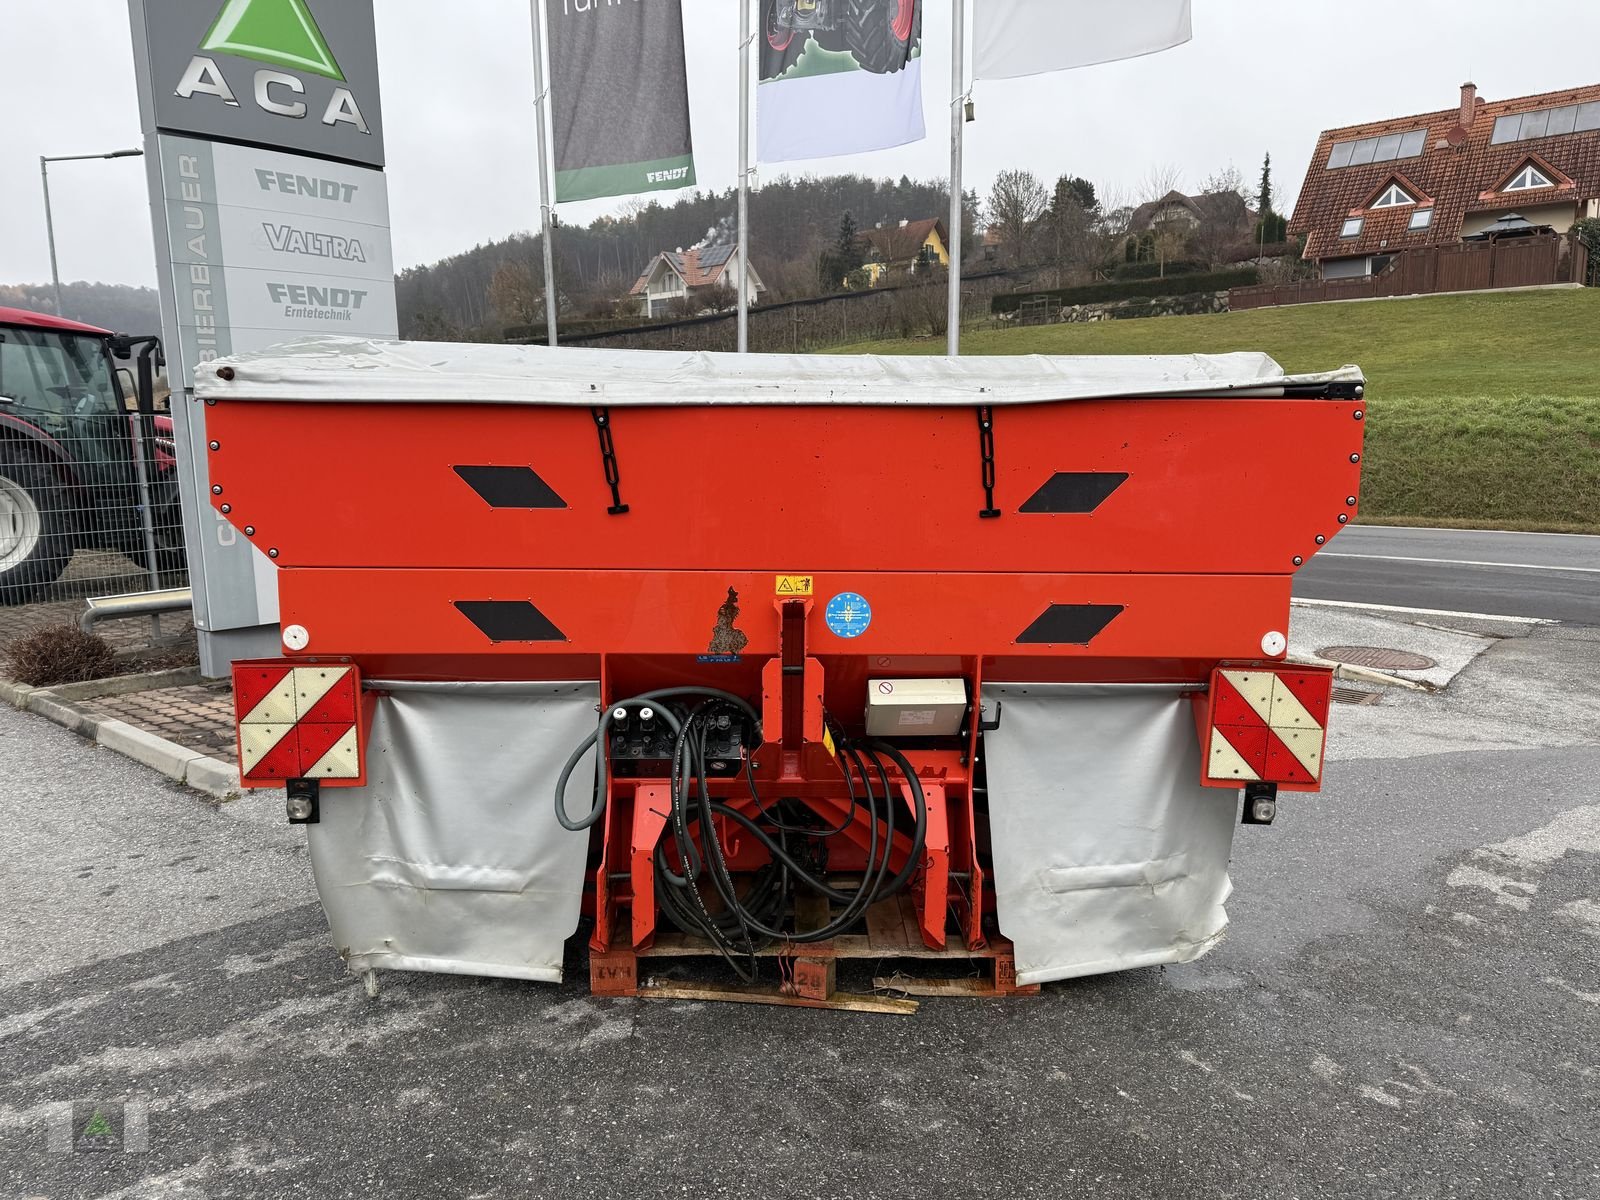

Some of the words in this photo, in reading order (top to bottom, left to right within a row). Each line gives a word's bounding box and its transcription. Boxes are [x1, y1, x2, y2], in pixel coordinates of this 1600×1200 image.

[173, 55, 372, 135] ACA
[254, 168, 358, 203] FENDT
[646, 166, 689, 183] FENDT
[262, 222, 366, 263] VALTRA
[266, 282, 368, 309] FENDT
[284, 305, 352, 321] Erntetechnik
